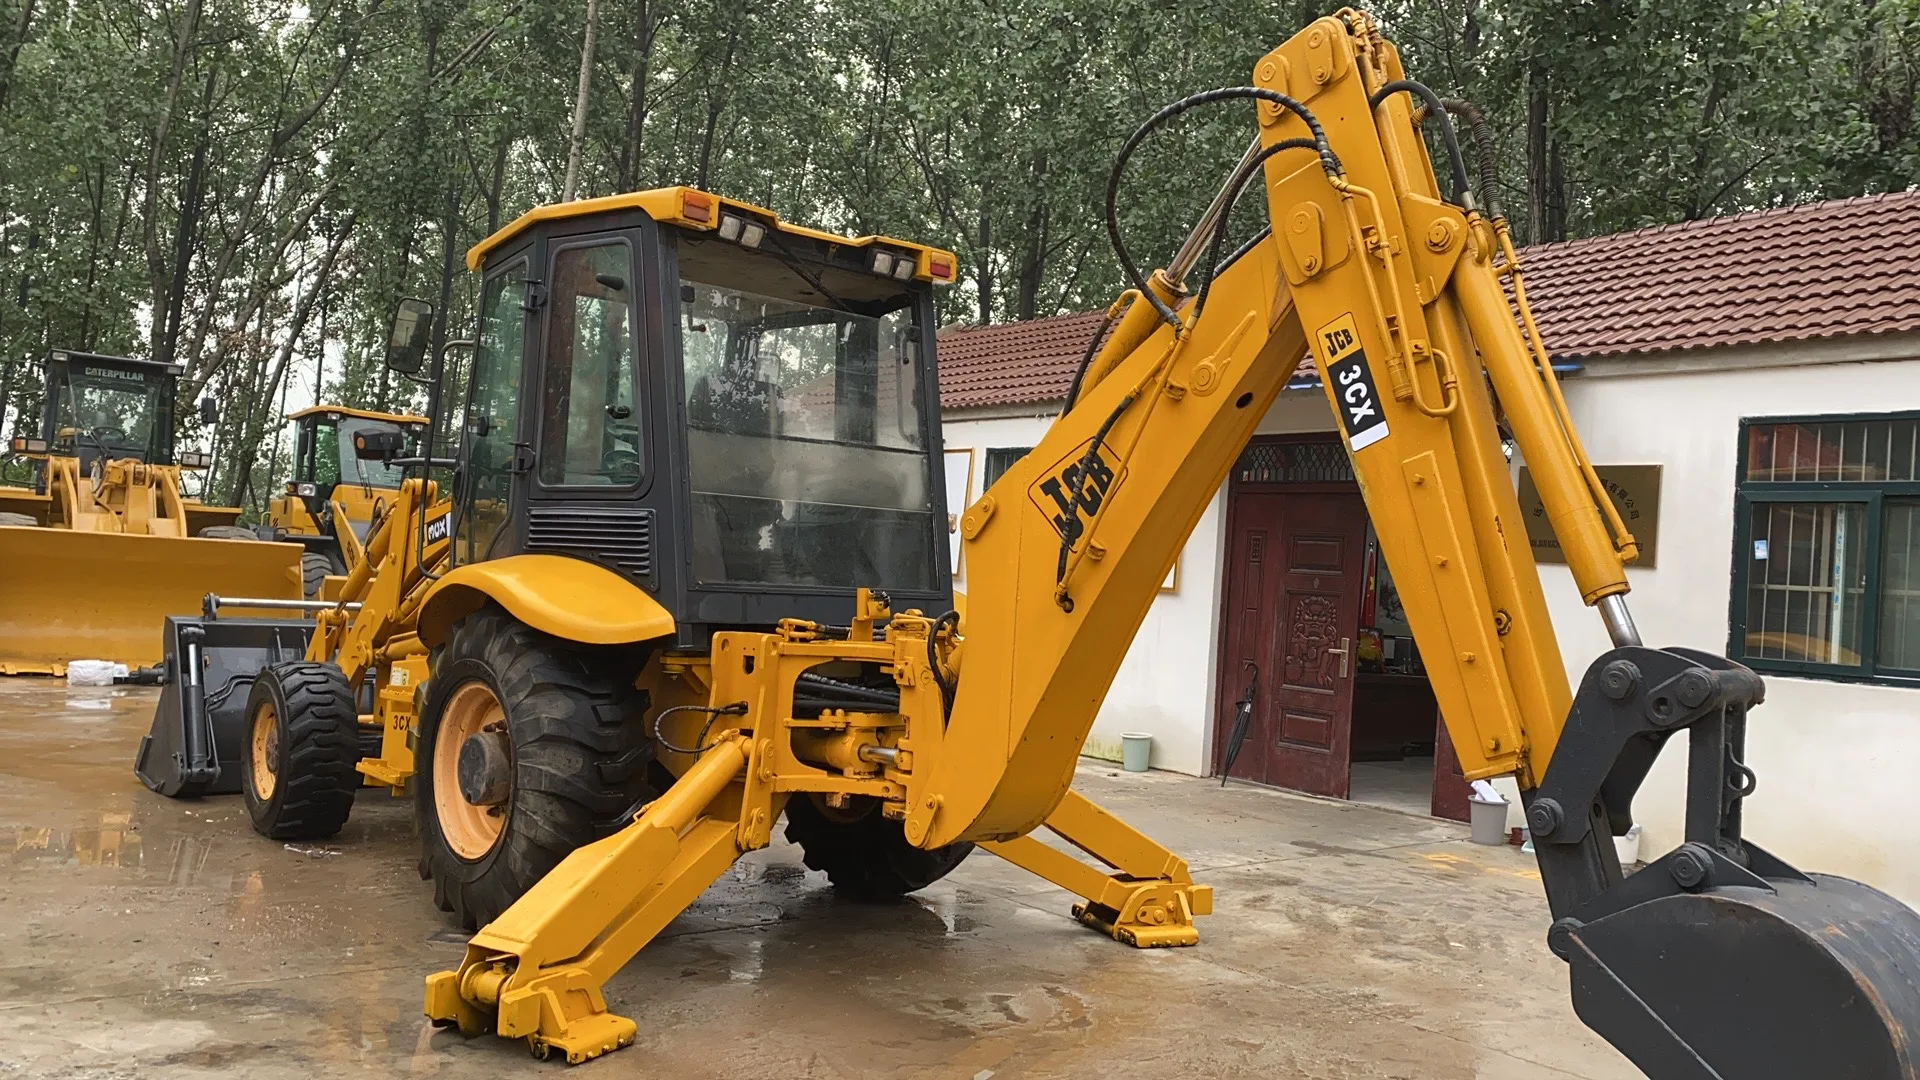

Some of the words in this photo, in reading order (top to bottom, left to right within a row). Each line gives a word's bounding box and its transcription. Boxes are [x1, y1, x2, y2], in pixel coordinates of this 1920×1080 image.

[1325, 328, 1353, 358] JCB
[84, 366, 144, 381] CATERPILLAR
[1339, 364, 1375, 426] 3CX
[1039, 452, 1115, 548] JCB
[392, 714, 412, 731] 3CX
